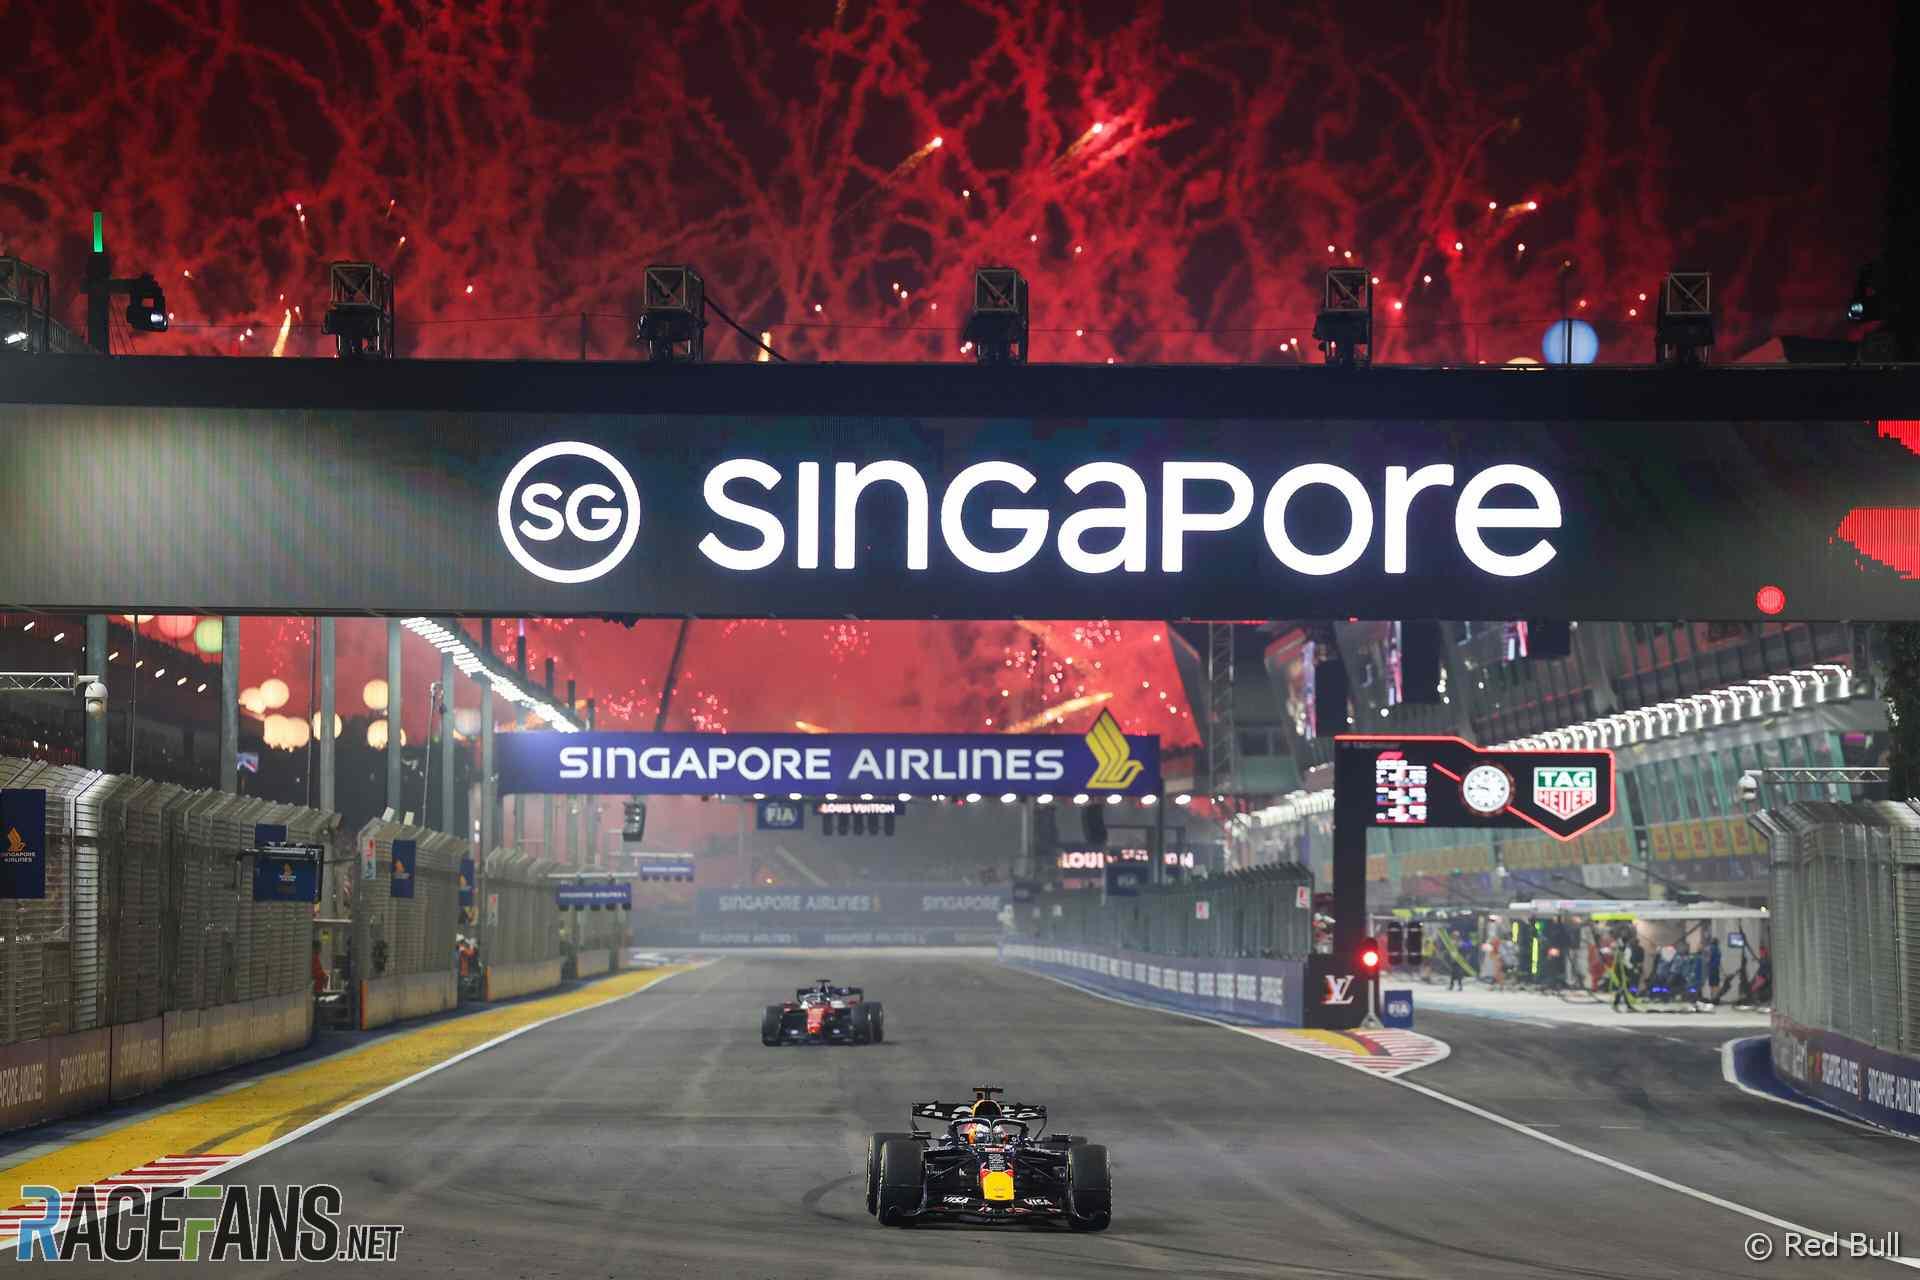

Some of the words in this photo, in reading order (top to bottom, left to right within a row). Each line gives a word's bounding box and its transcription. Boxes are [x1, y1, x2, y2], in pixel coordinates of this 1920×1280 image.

[519, 482, 622, 541] SG
[559, 746, 832, 780] SINGAPORE
[849, 747, 1064, 780] AIRLINES
[1538, 771, 1592, 787] TAG
[852, 803, 895, 813] VUITTON
[1537, 790, 1592, 817] HEUER
[766, 807, 793, 822] FIA
[1060, 851, 1117, 868] LOUI
[720, 895, 801, 911] SINGAPORE
[805, 895, 870, 911] AIRLINES
[922, 895, 1000, 911] SINGAPORE
[1387, 1001, 1410, 1014] FIA
[943, 1195, 970, 1204] VISA
